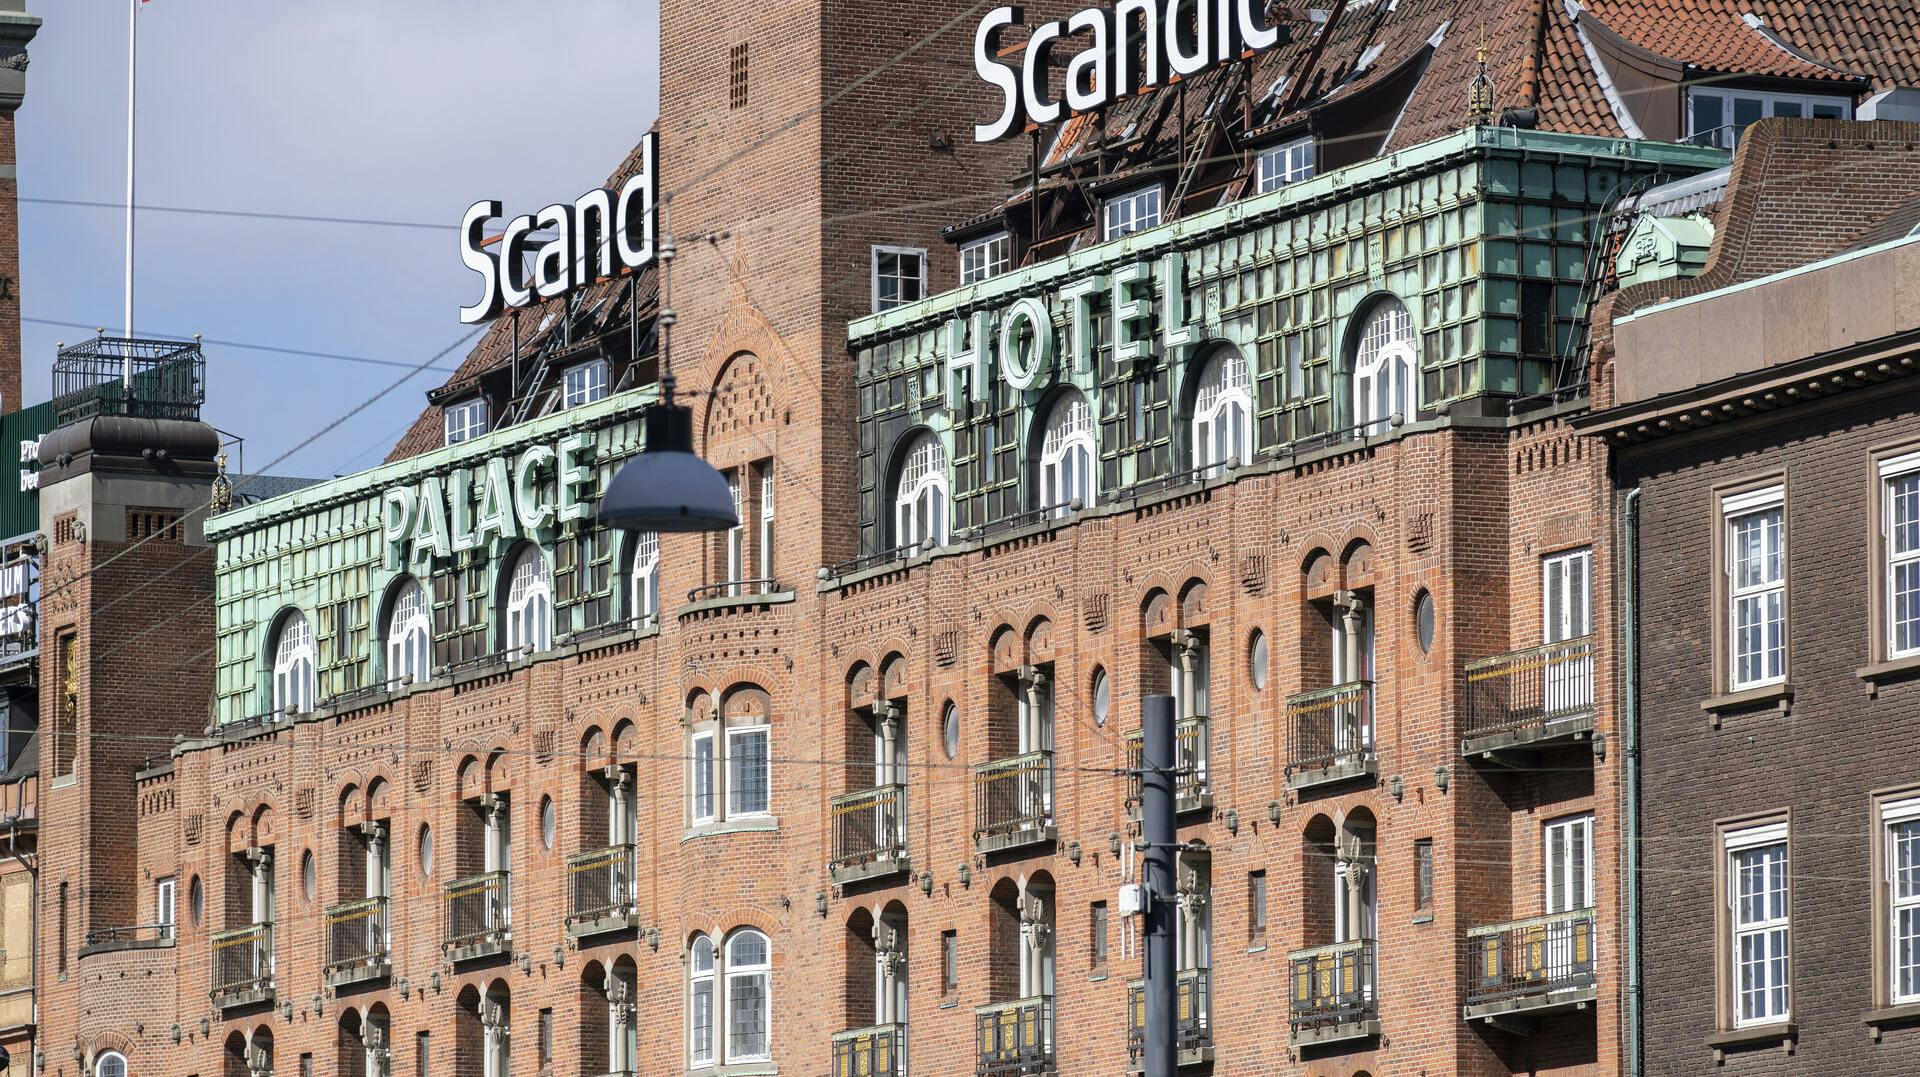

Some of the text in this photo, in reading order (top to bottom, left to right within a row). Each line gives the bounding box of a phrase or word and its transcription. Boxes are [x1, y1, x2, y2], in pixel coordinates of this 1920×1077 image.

[459, 132, 658, 325] Scand
[944, 252, 1201, 410] HOTEL
[20, 434, 47, 462] Pro
[384, 433, 590, 571] PALACE
